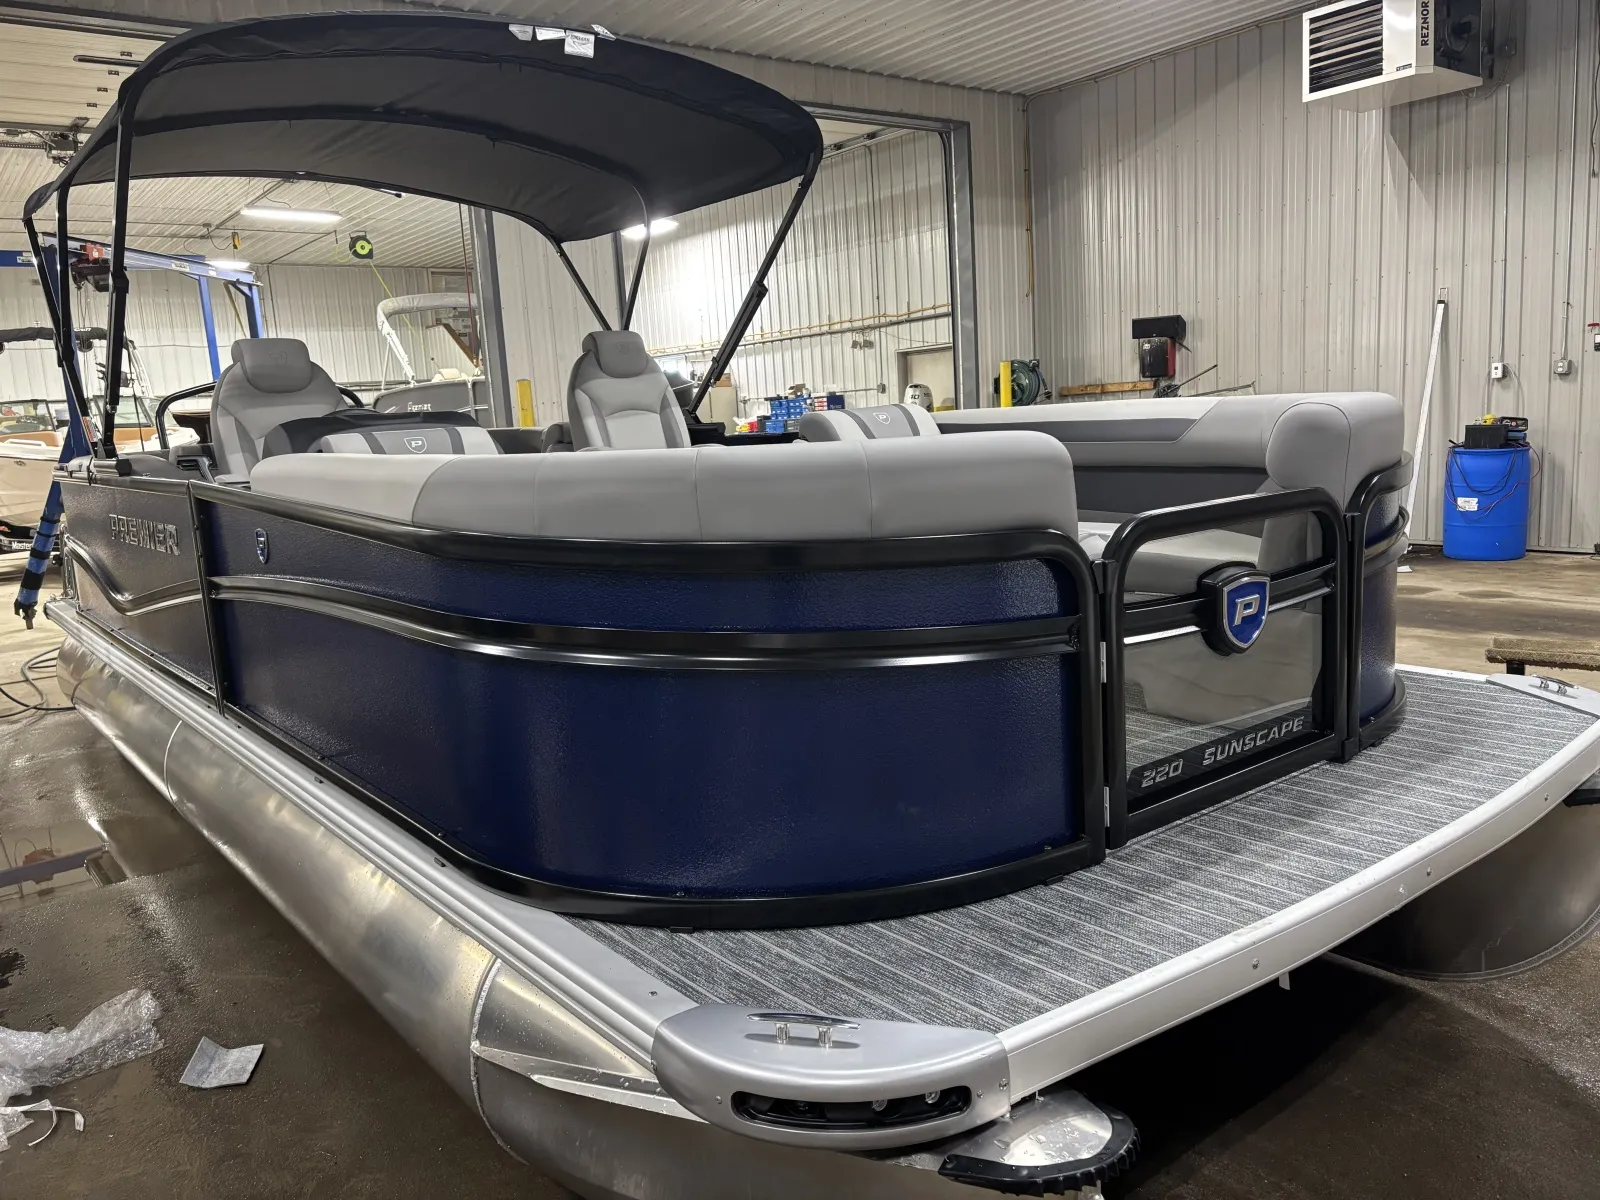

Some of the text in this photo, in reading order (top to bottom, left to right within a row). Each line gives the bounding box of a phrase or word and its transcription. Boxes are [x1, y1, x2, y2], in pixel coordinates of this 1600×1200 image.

[1420, 0, 1430, 46] REZNOR
[108, 513, 181, 556] PREMIER
[1232, 593, 1261, 627] P
[1140, 715, 1305, 788] 220 SUNSCAPE
